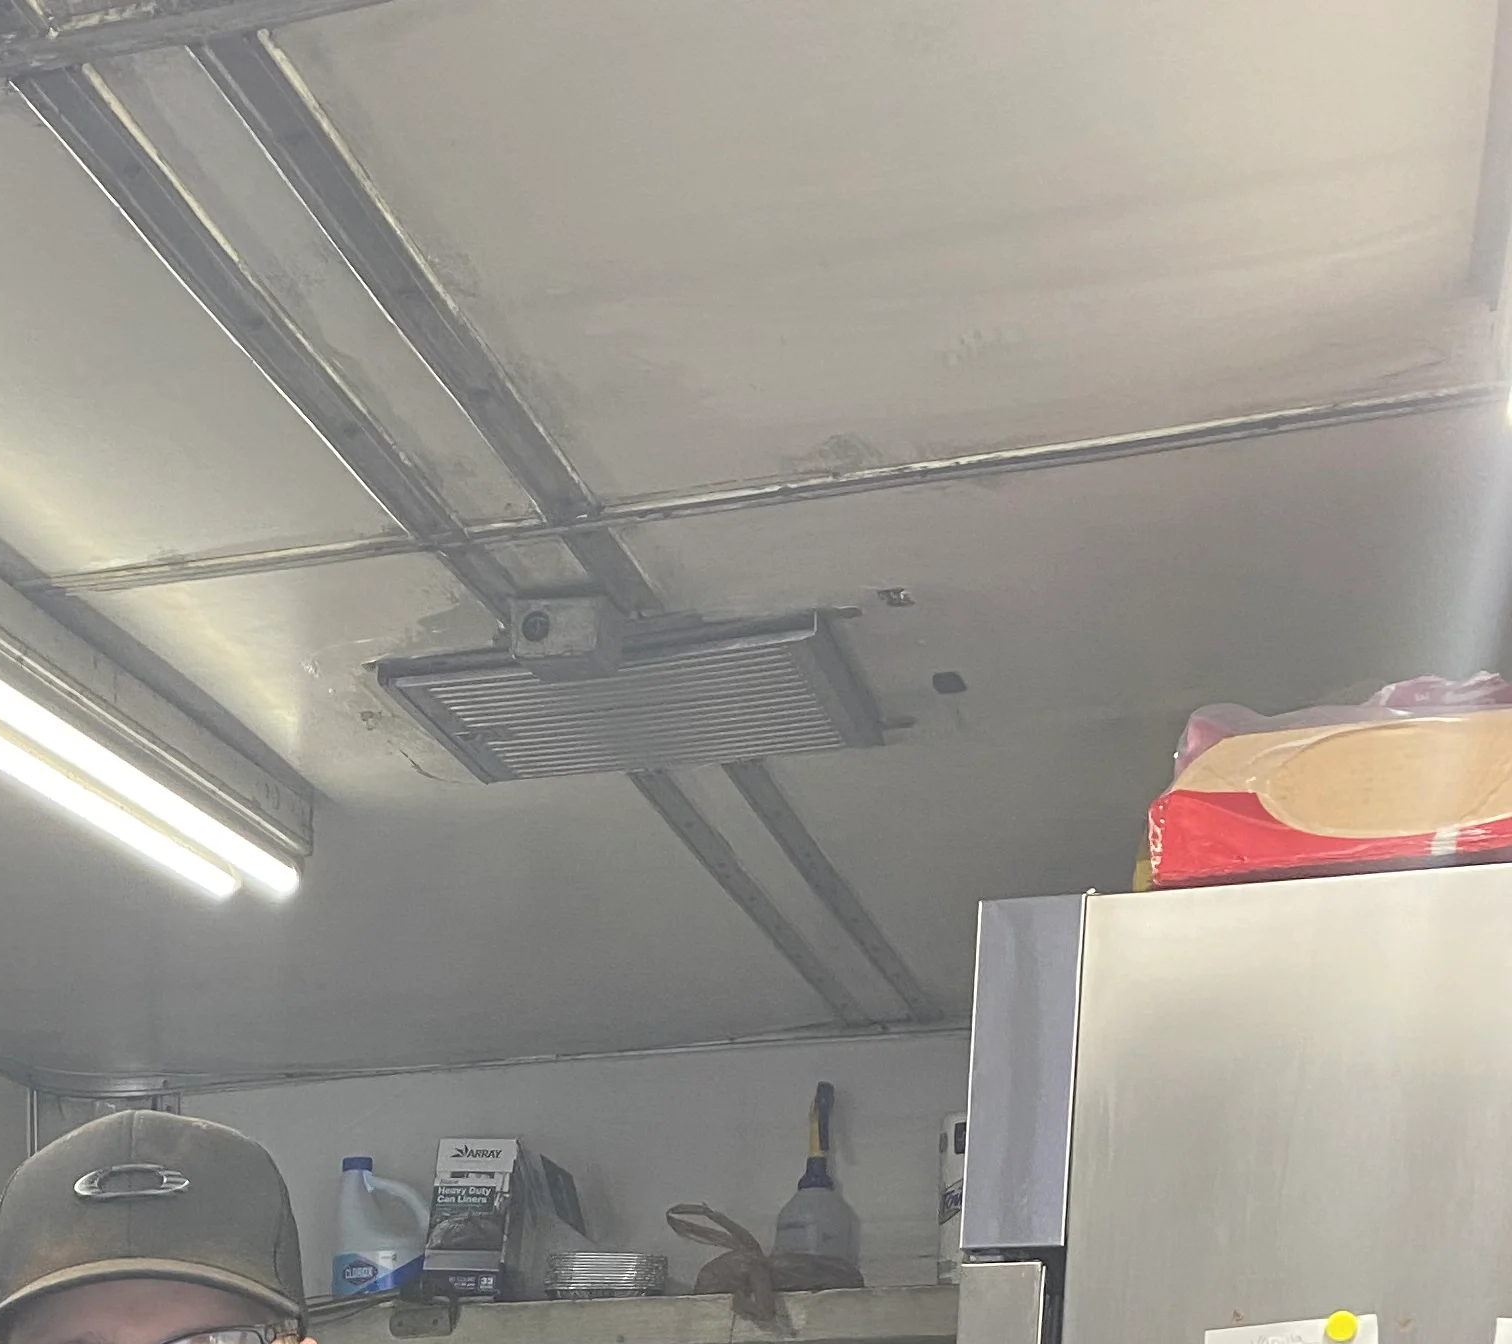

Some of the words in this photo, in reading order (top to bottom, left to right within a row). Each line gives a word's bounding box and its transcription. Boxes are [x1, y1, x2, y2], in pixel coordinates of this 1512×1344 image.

[467, 1149, 503, 1159] ARRAY
[438, 1187, 467, 1196] Heavy
[468, 1186, 492, 1197] Duty
[437, 1196, 456, 1204] Can
[457, 1195, 488, 1204] Liners
